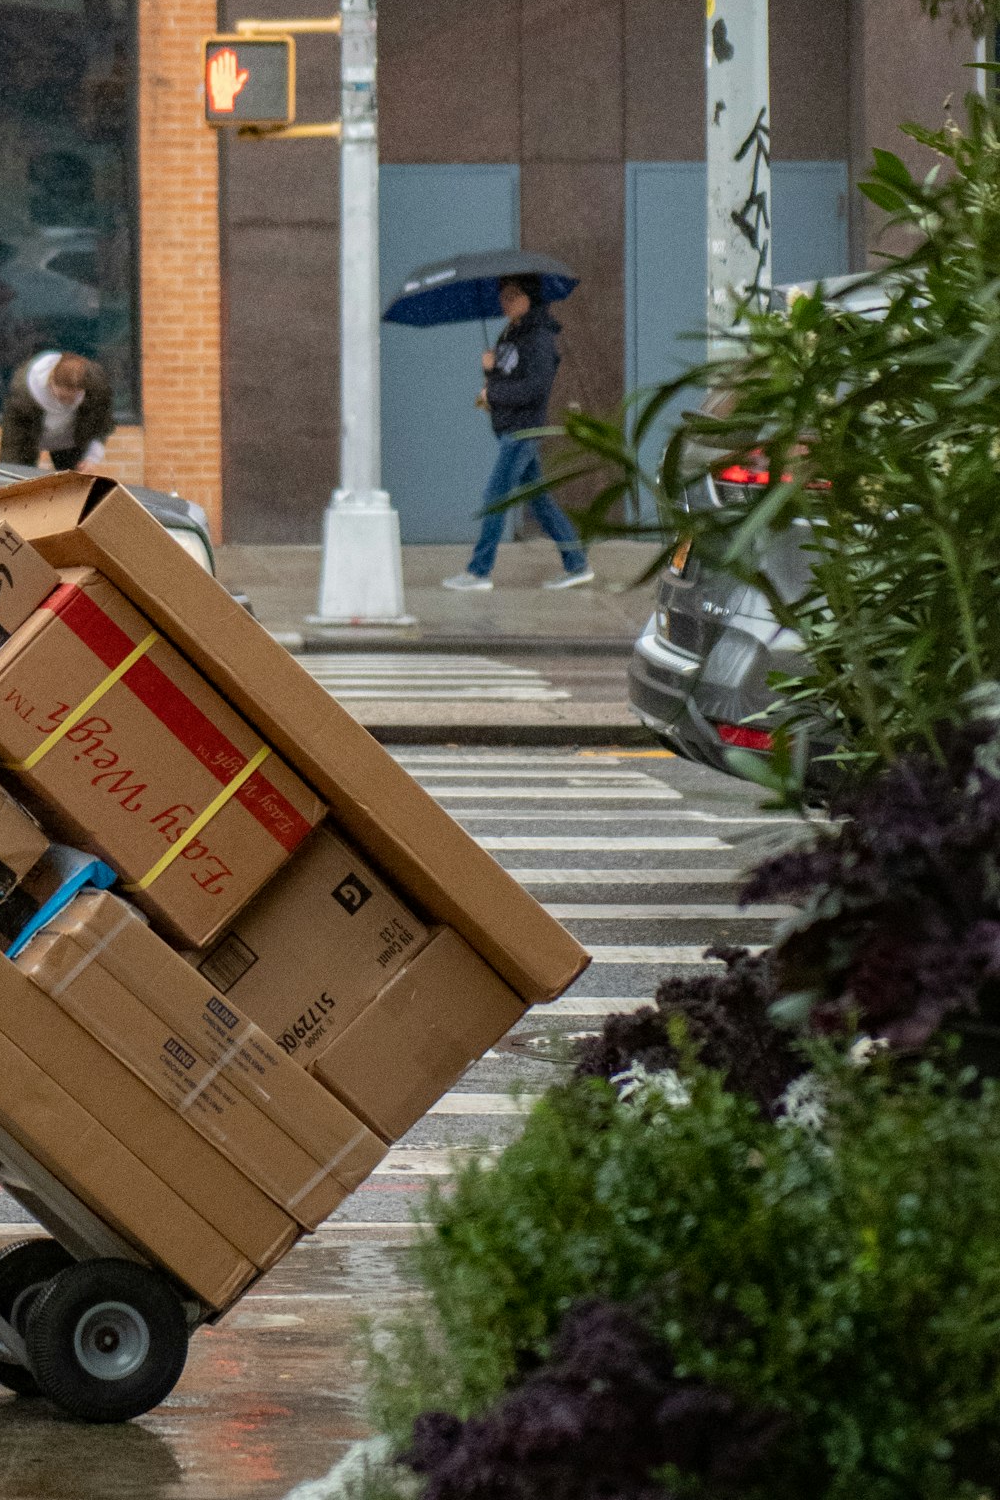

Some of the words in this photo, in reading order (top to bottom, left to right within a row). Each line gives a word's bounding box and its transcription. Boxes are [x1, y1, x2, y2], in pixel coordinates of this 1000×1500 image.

[37, 702, 148, 812] Weigh
[152, 804, 232, 895] Easy
[379, 918, 404, 944] 3/33
[207, 998, 237, 1028] ULINE
[165, 1040, 195, 1068] ULINE
